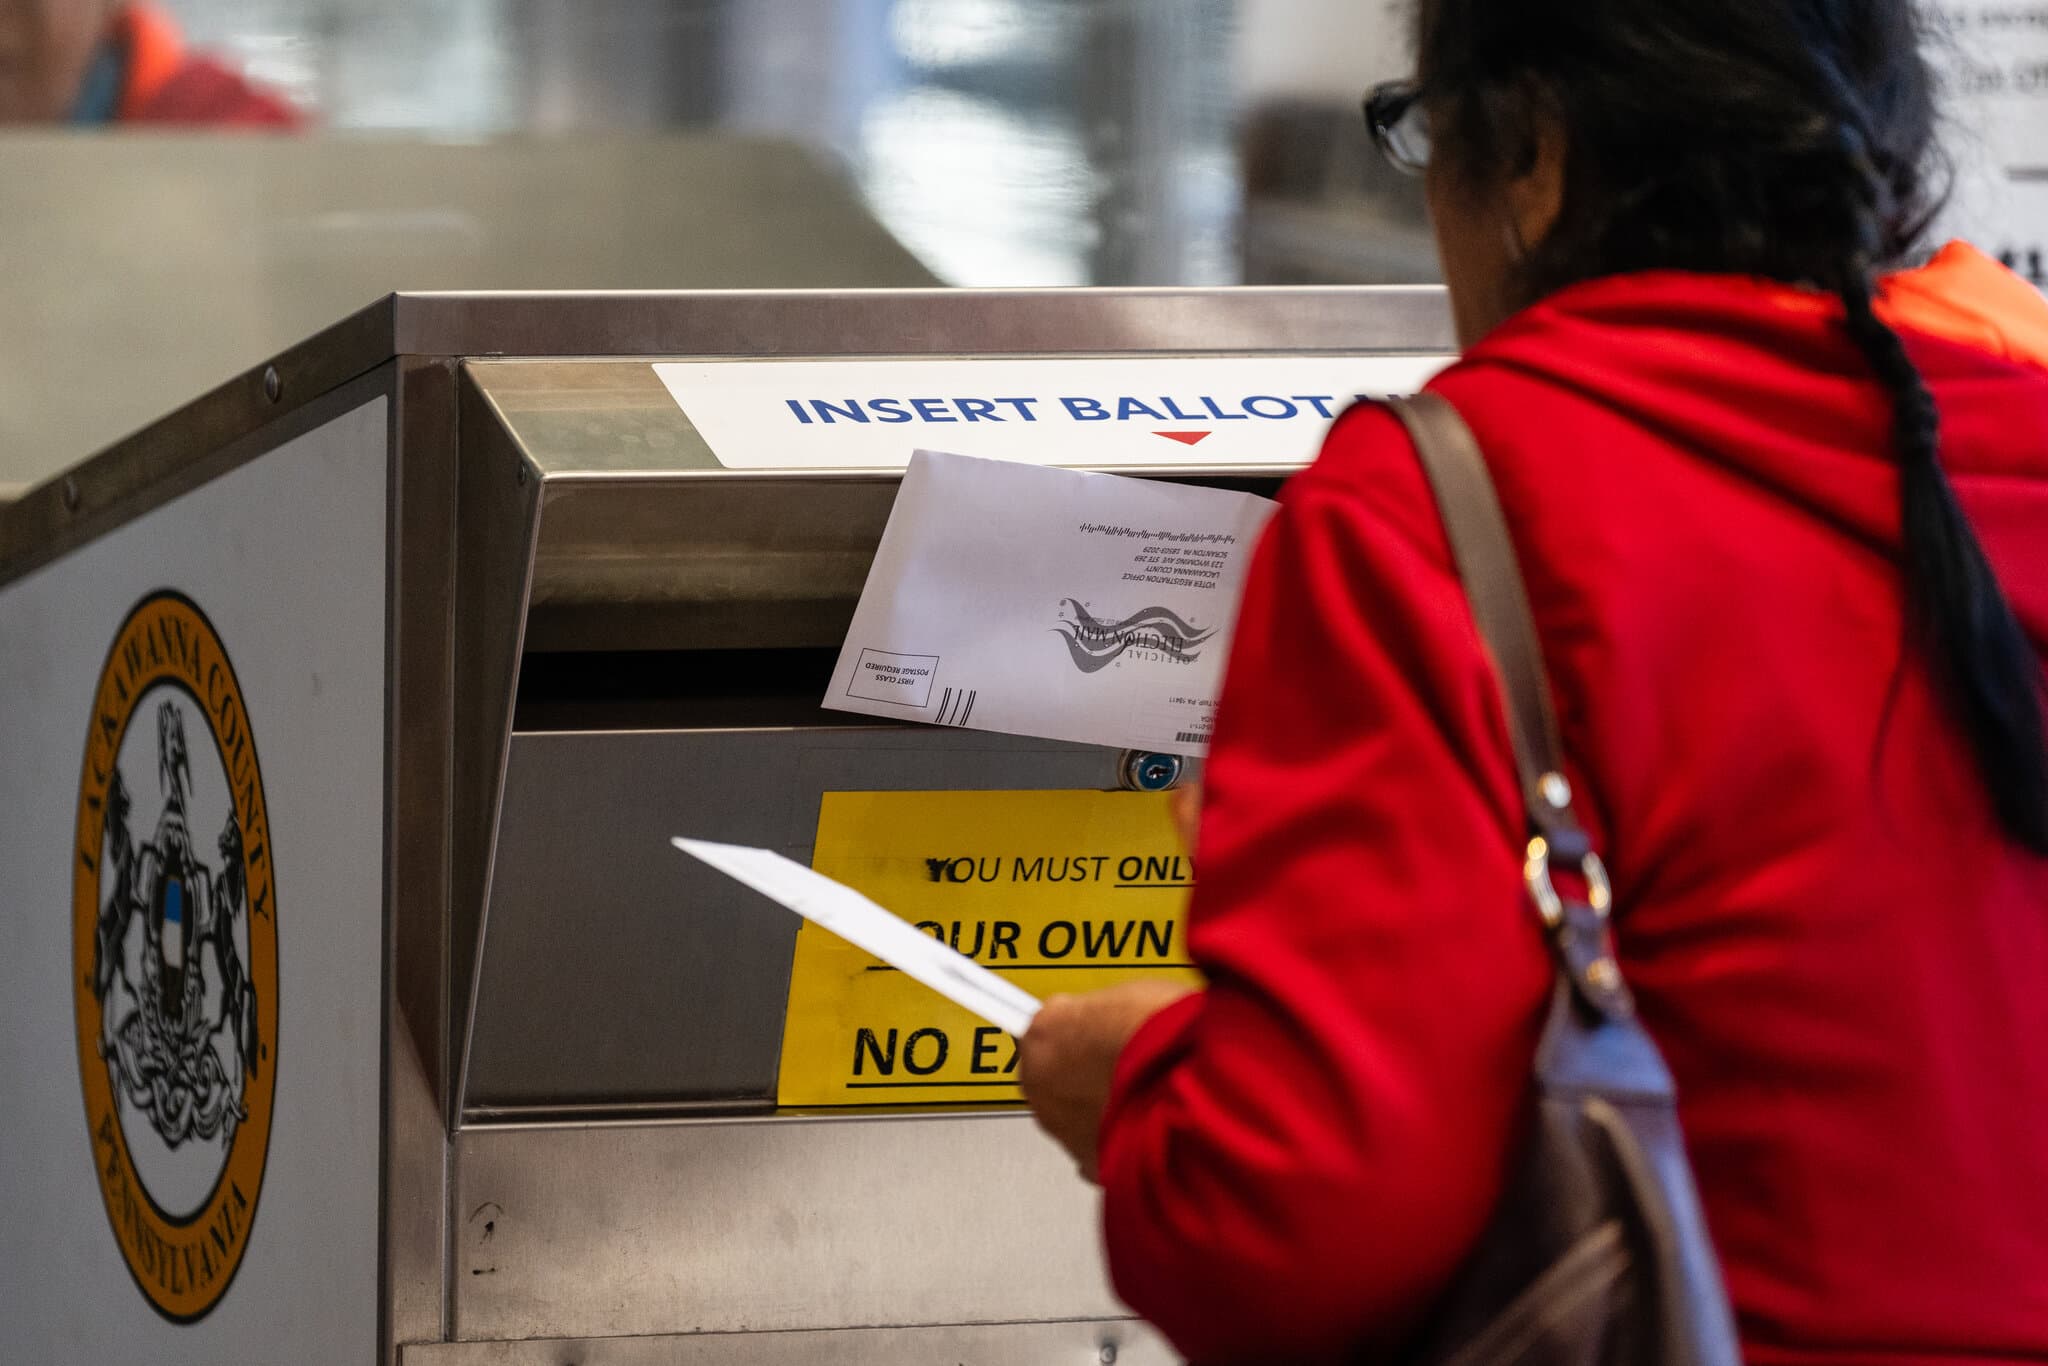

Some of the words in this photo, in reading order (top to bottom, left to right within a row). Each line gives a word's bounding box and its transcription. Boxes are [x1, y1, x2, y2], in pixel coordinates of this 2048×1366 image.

[785, 397, 1039, 424] INSERT
[1056, 395, 1334, 421] BALLOT
[1121, 573, 1145, 581] OFFICE
[1146, 575, 1193, 587] REGISTRATION
[1193, 580, 1216, 589] VOTER
[1074, 624, 1109, 641] MAIL
[1111, 630, 1184, 652] ELECTION
[1126, 649, 1191, 666] OFFICIAL
[865, 662, 901, 674] REQUIRED
[900, 667, 930, 676] POSTAGE
[875, 674, 896, 684] CLASS
[896, 677, 915, 686] FIRST
[925, 856, 1001, 883] YOU
[1011, 856, 1110, 883] MUST
[915, 920, 1021, 960] OUR
[1038, 920, 1174, 959] OWN
[852, 1027, 950, 1076] NO
